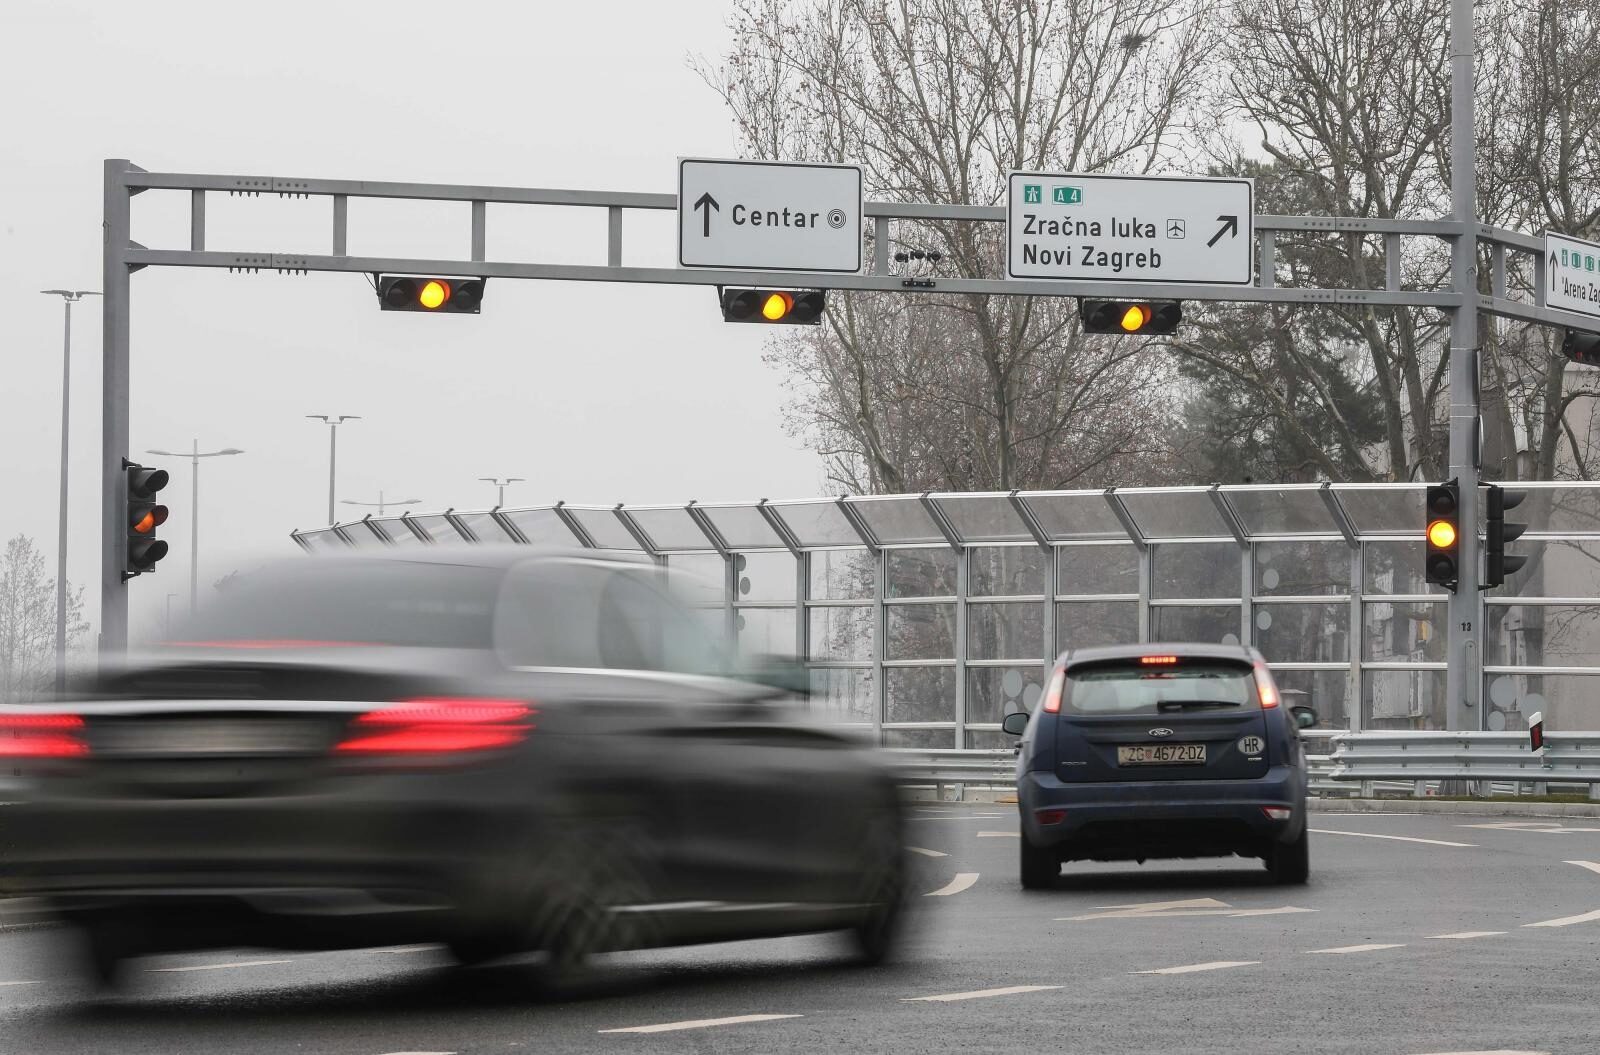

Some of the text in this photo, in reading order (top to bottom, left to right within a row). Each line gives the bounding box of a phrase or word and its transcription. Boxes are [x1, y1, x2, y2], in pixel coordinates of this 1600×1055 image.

[1057, 189, 1078, 202] A 4
[732, 203, 820, 228] Centar
[1023, 214, 1156, 239] Zračna luka
[1023, 243, 1162, 273] Novi Zagreb
[1127, 747, 1144, 762] ZG
[1243, 737, 1260, 753] HR
